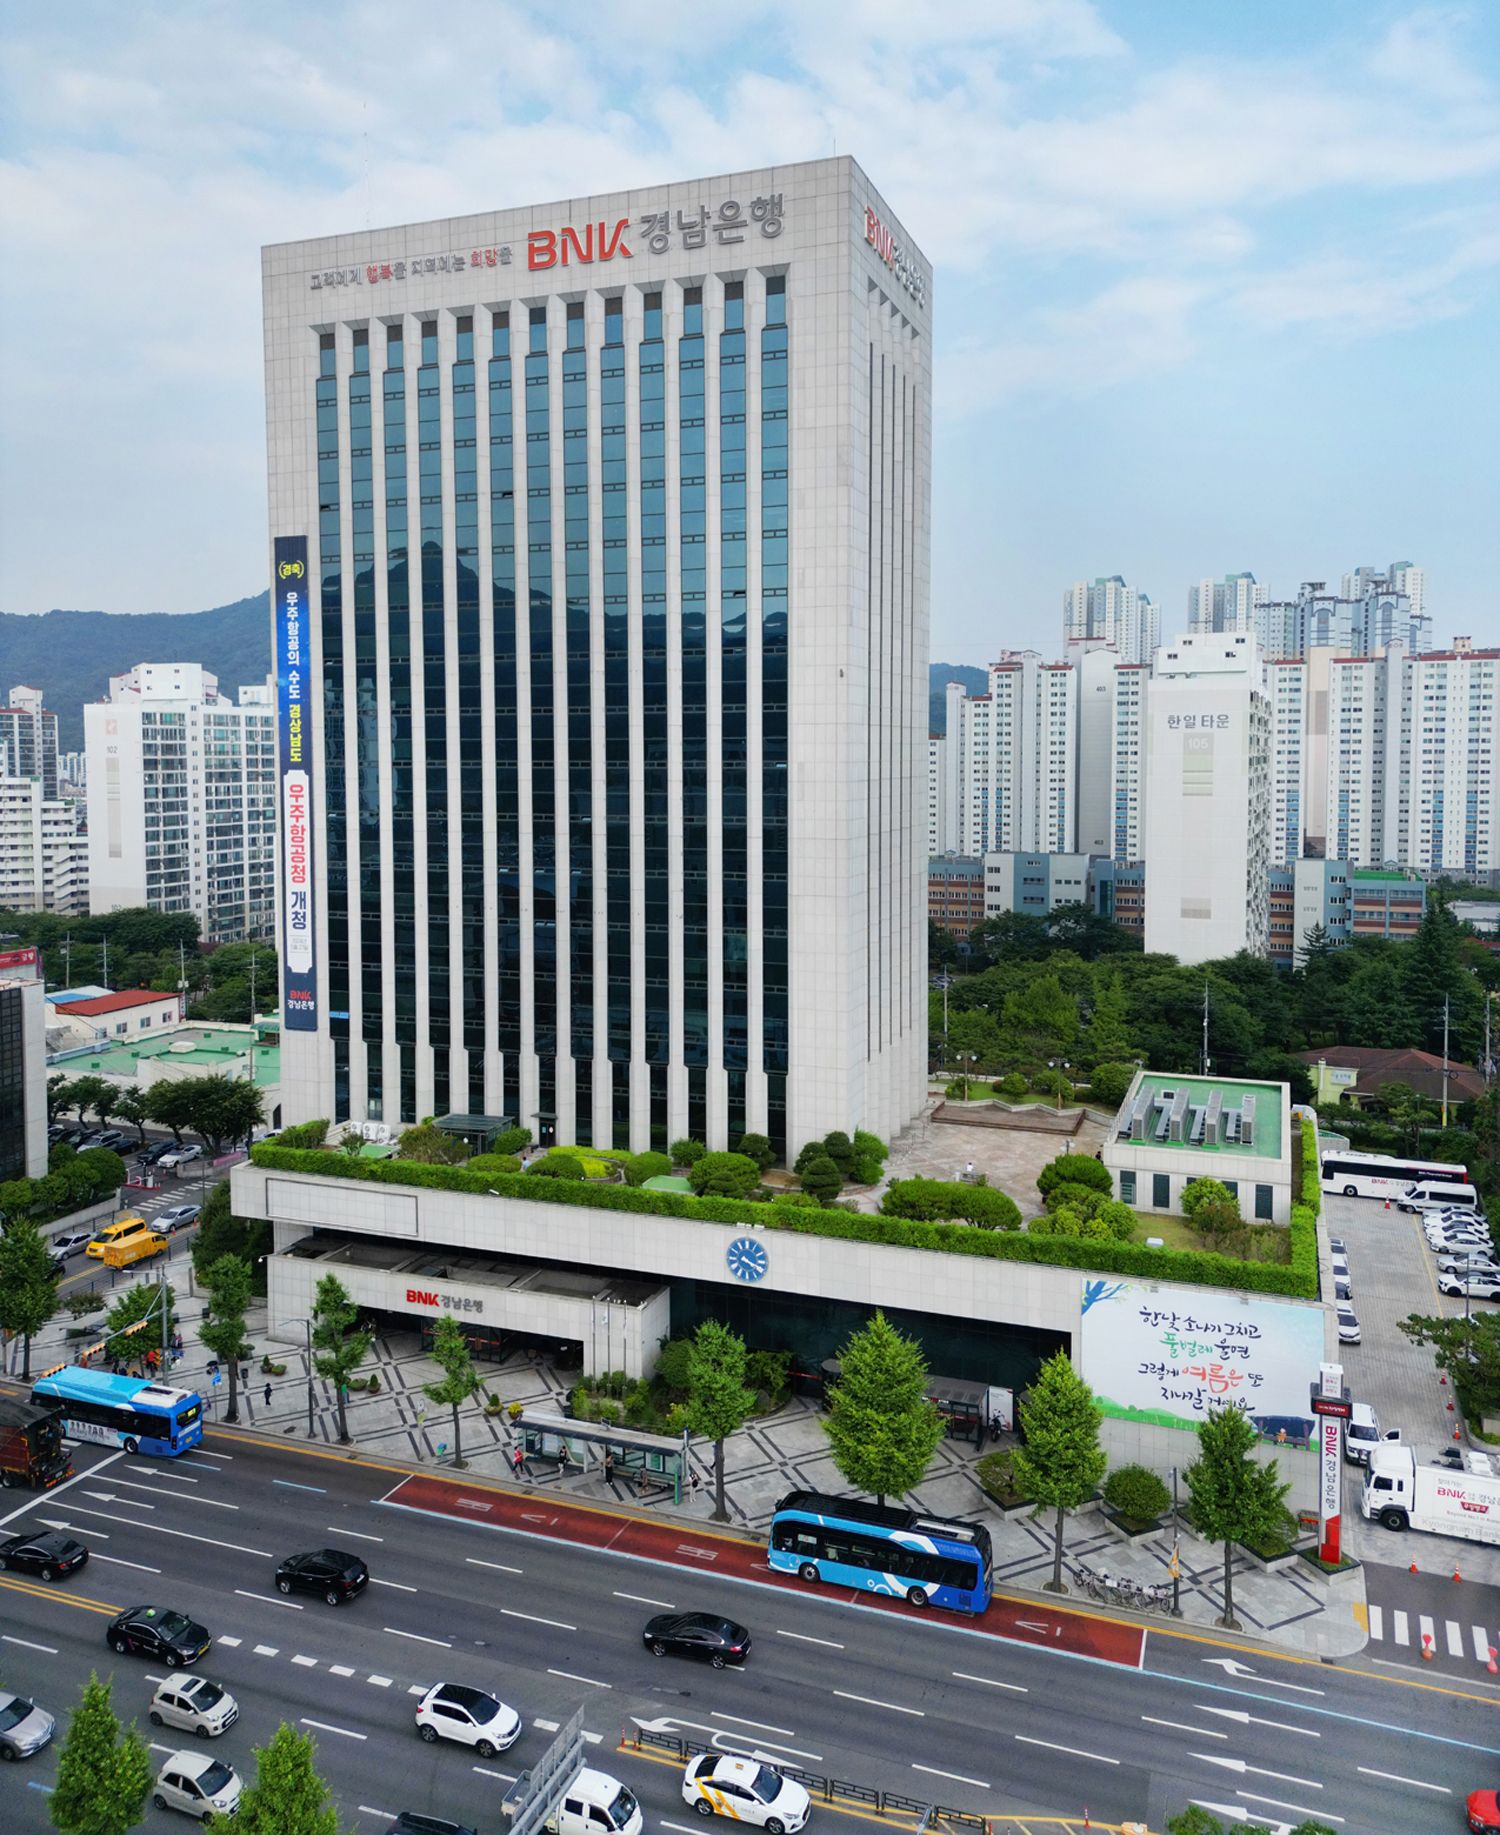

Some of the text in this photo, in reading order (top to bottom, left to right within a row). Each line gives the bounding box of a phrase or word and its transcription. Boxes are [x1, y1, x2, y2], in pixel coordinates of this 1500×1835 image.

[528, 193, 784, 270] BNK 경남은행
[366, 261, 407, 285] 행복을
[470, 246, 513, 269] 희망을
[287, 592, 302, 763] 우주항공의 수도 경상남도
[1167, 714, 1230, 729] 한일 타운
[106, 745, 118, 754] 102
[1187, 737, 1209, 750] 105
[289, 784, 306, 884] 우주항공청
[291, 890, 307, 930] 개청
[289, 990, 311, 1001] BNK
[406, 1289, 483, 1314] BNK 경남은행
[1139, 1306, 1262, 1339] 한낮 소나기 그치고
[1160, 1331, 1250, 1360] 풀벌레 울면
[1138, 1362, 1264, 1393] 그렇게 여름은 또
[1161, 1387, 1207, 1410] 지나갈
[1325, 1425, 1337, 1458] BNK
[1325, 1459, 1336, 1510] 경남은행
[1437, 1487, 1466, 1500] BNK
